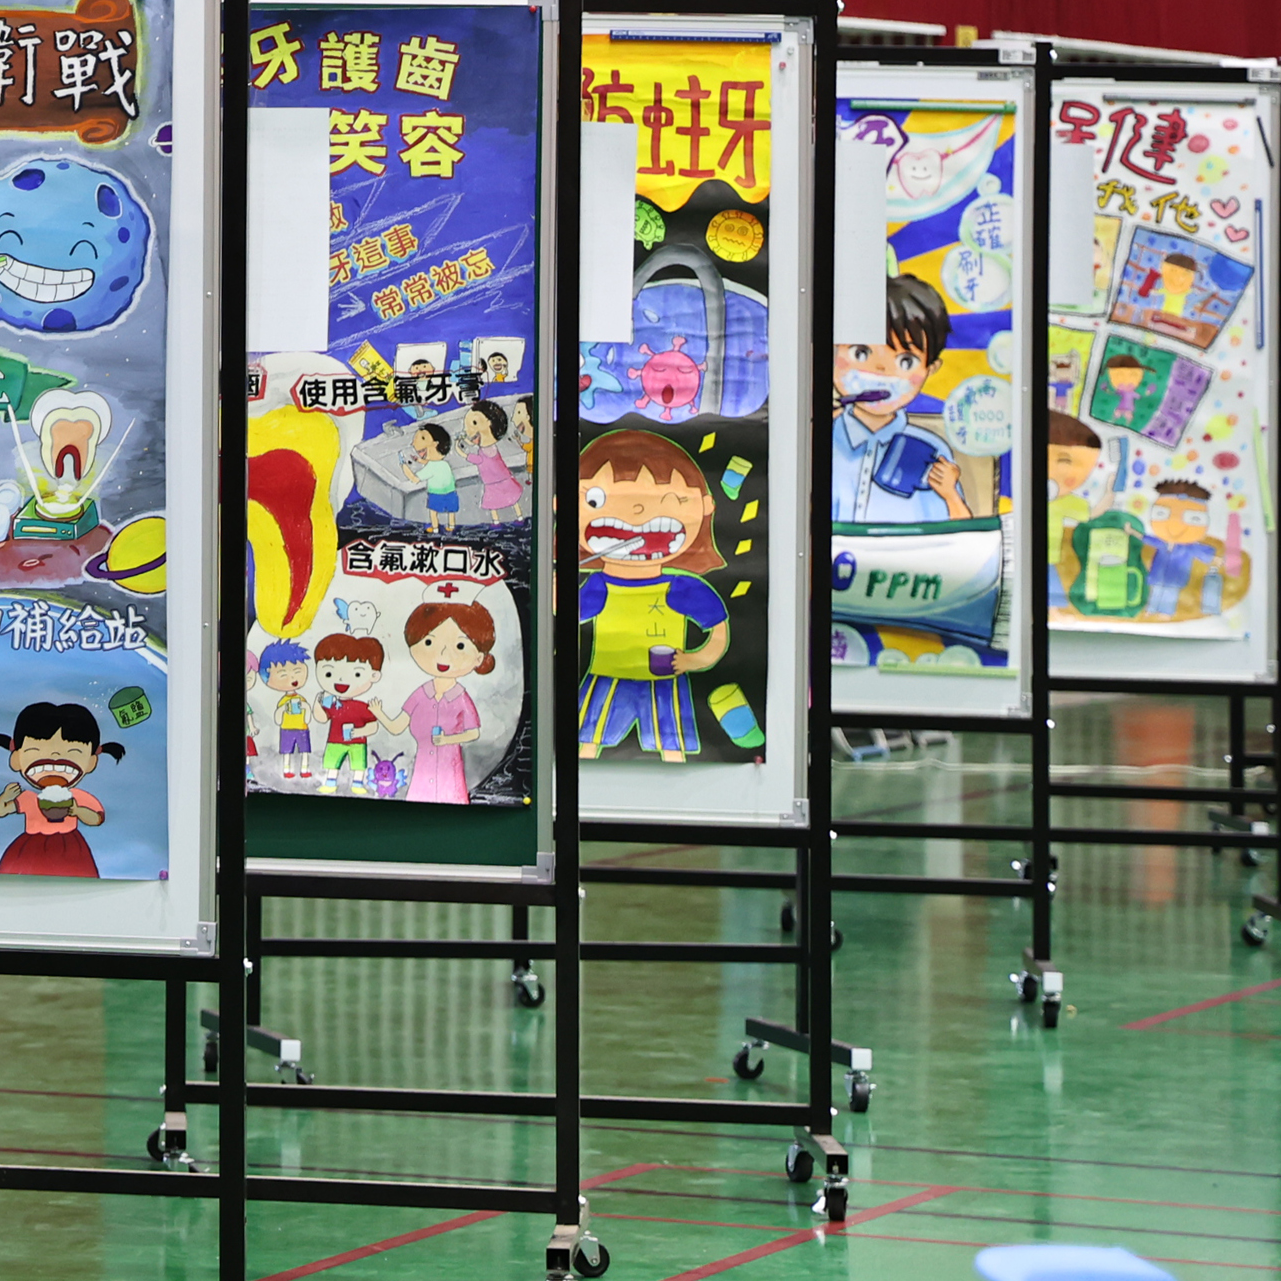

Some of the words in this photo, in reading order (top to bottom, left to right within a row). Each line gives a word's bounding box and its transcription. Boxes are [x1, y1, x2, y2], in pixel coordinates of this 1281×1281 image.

[330, 111, 464, 178] 笑容
[373, 251, 492, 319] 常常被忘
[298, 372, 485, 409] 使用含氟牙膏
[345, 540, 506, 579] 含氟漱口水
